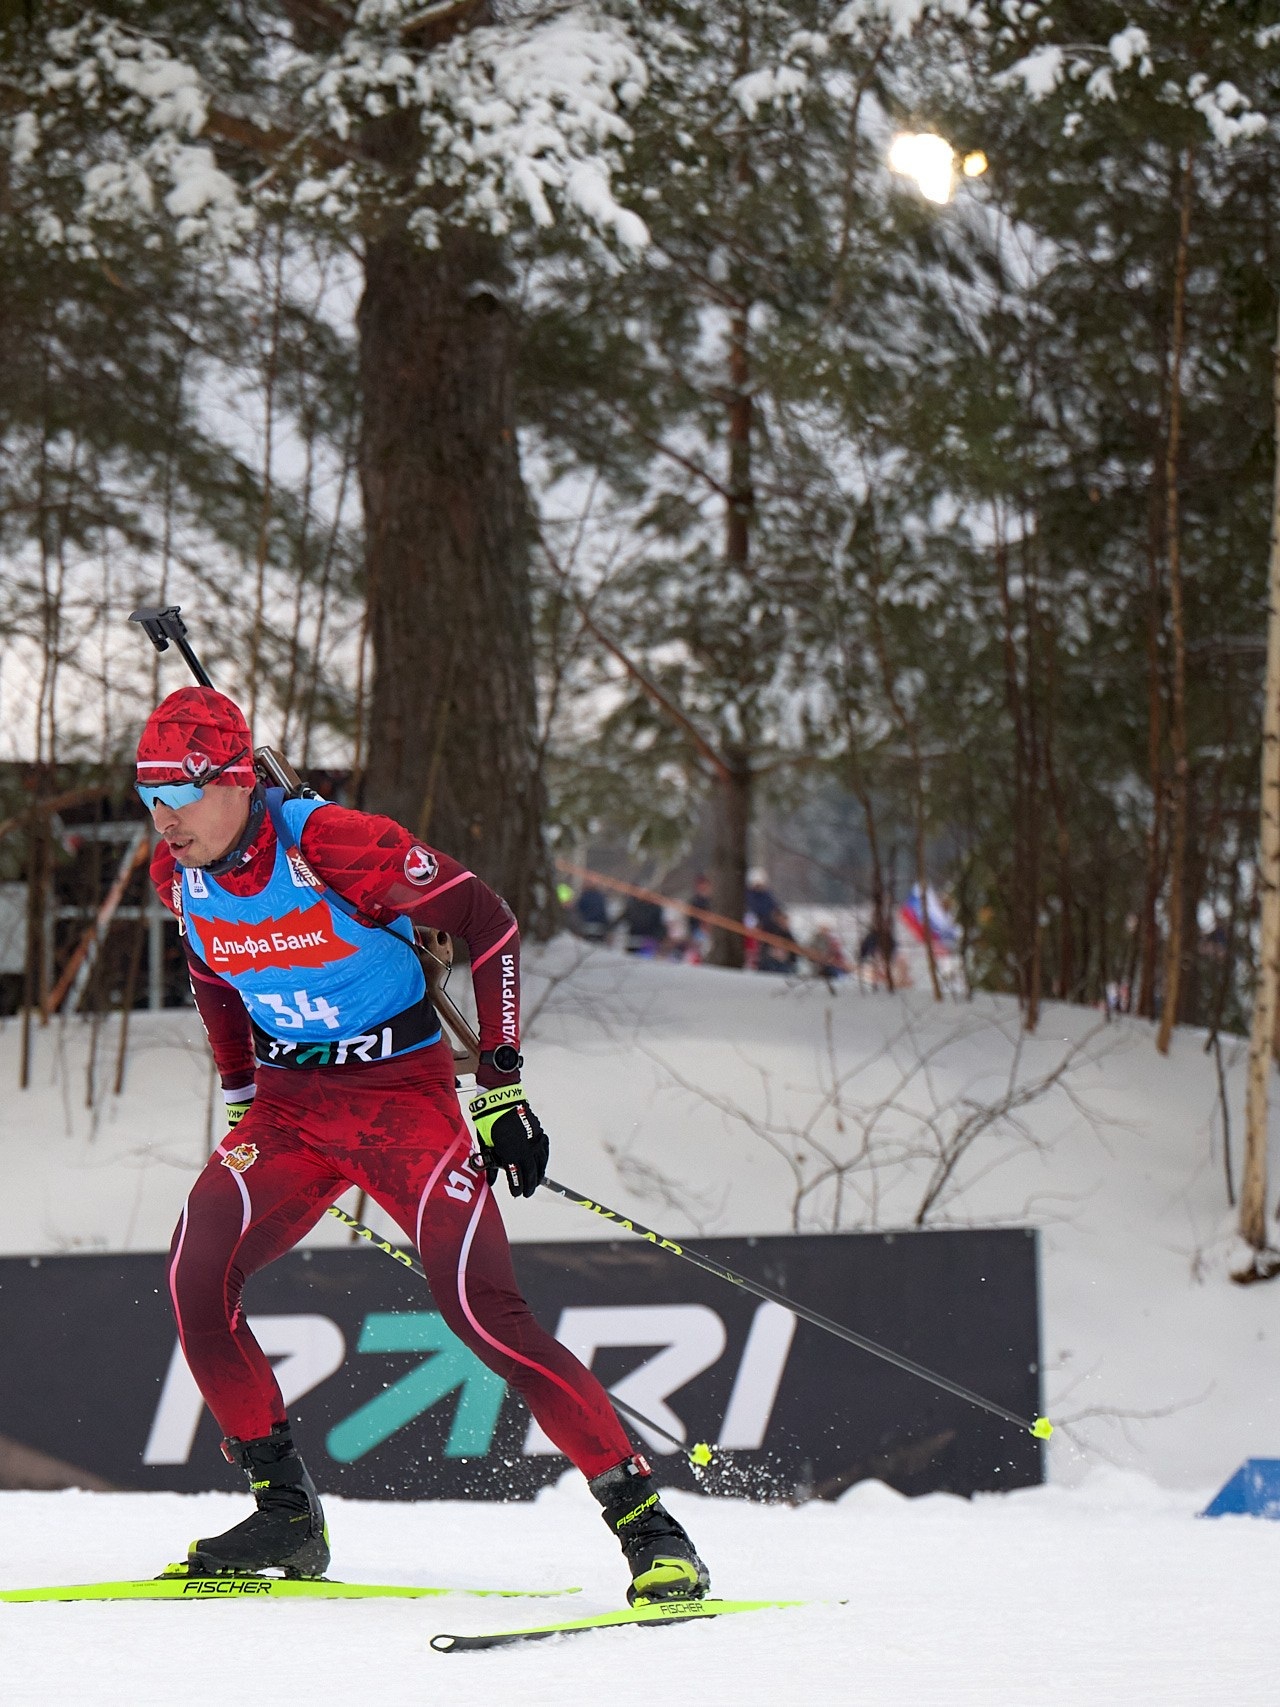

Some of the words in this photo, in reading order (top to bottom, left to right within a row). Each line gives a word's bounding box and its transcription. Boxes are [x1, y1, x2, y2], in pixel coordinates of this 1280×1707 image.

[212, 936, 271, 960] Альфа
[271, 930, 328, 951] Банк
[254, 990, 340, 1029] 34
[502, 954, 516, 1043] УДМУРТИЯ
[183, 1581, 272, 1594] FISCHER
[660, 1603, 705, 1615] FISCHER
